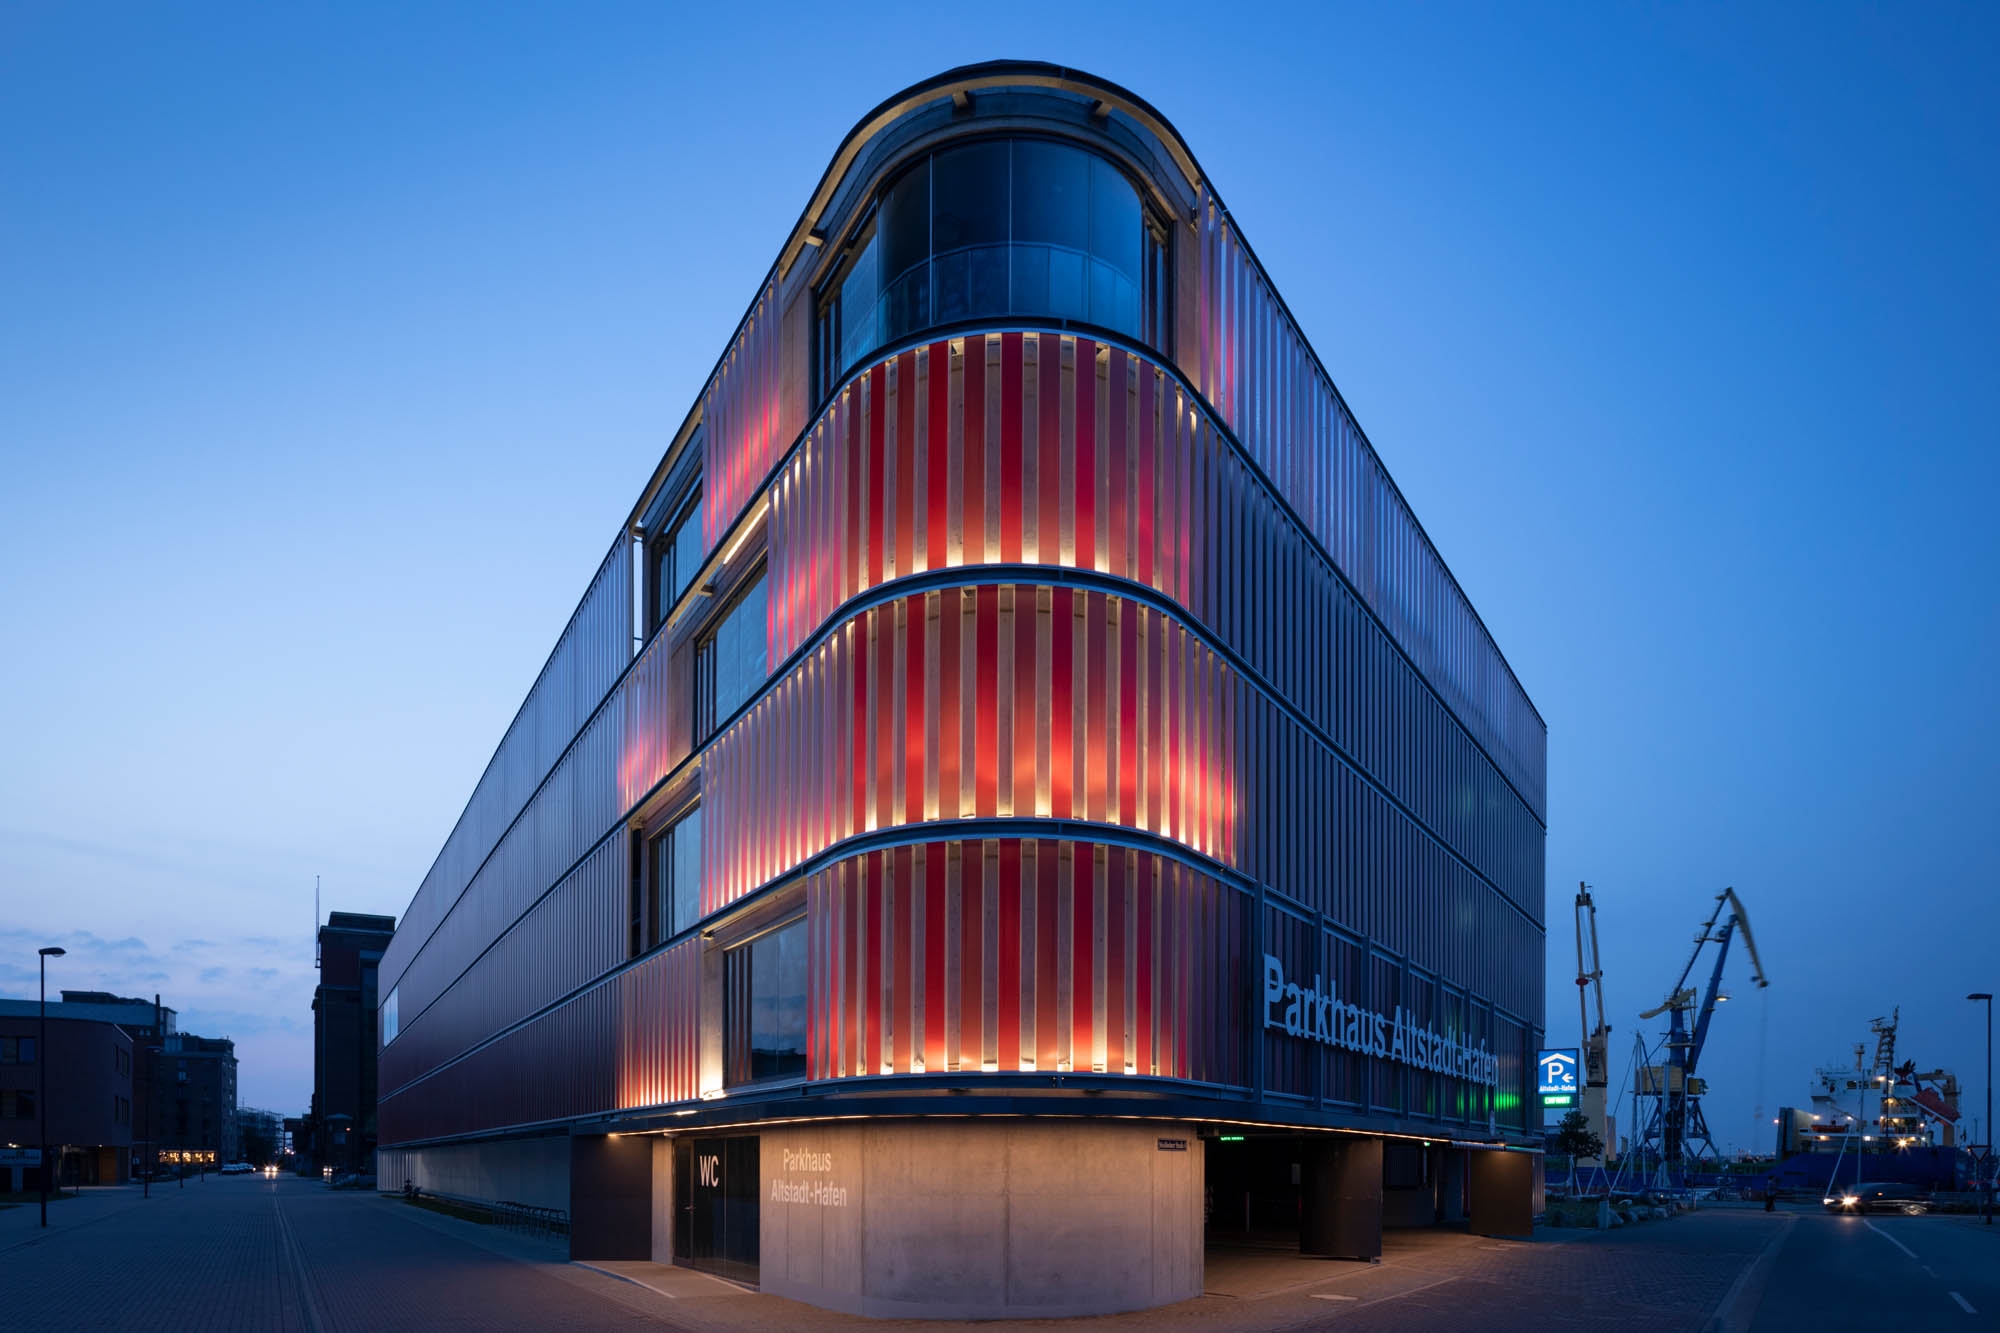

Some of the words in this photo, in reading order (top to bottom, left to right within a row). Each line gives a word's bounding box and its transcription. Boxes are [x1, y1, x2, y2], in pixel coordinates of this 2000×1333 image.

[1263, 953, 1385, 1058] Parkhaus
[1391, 1005, 1498, 1086] Altstadt-Hafen
[1548, 1062, 1564, 1083] P
[699, 1154, 719, 1188] WC
[783, 1147, 832, 1172] Parkhaus
[770, 1179, 848, 1207] Altstadt-Hafen
